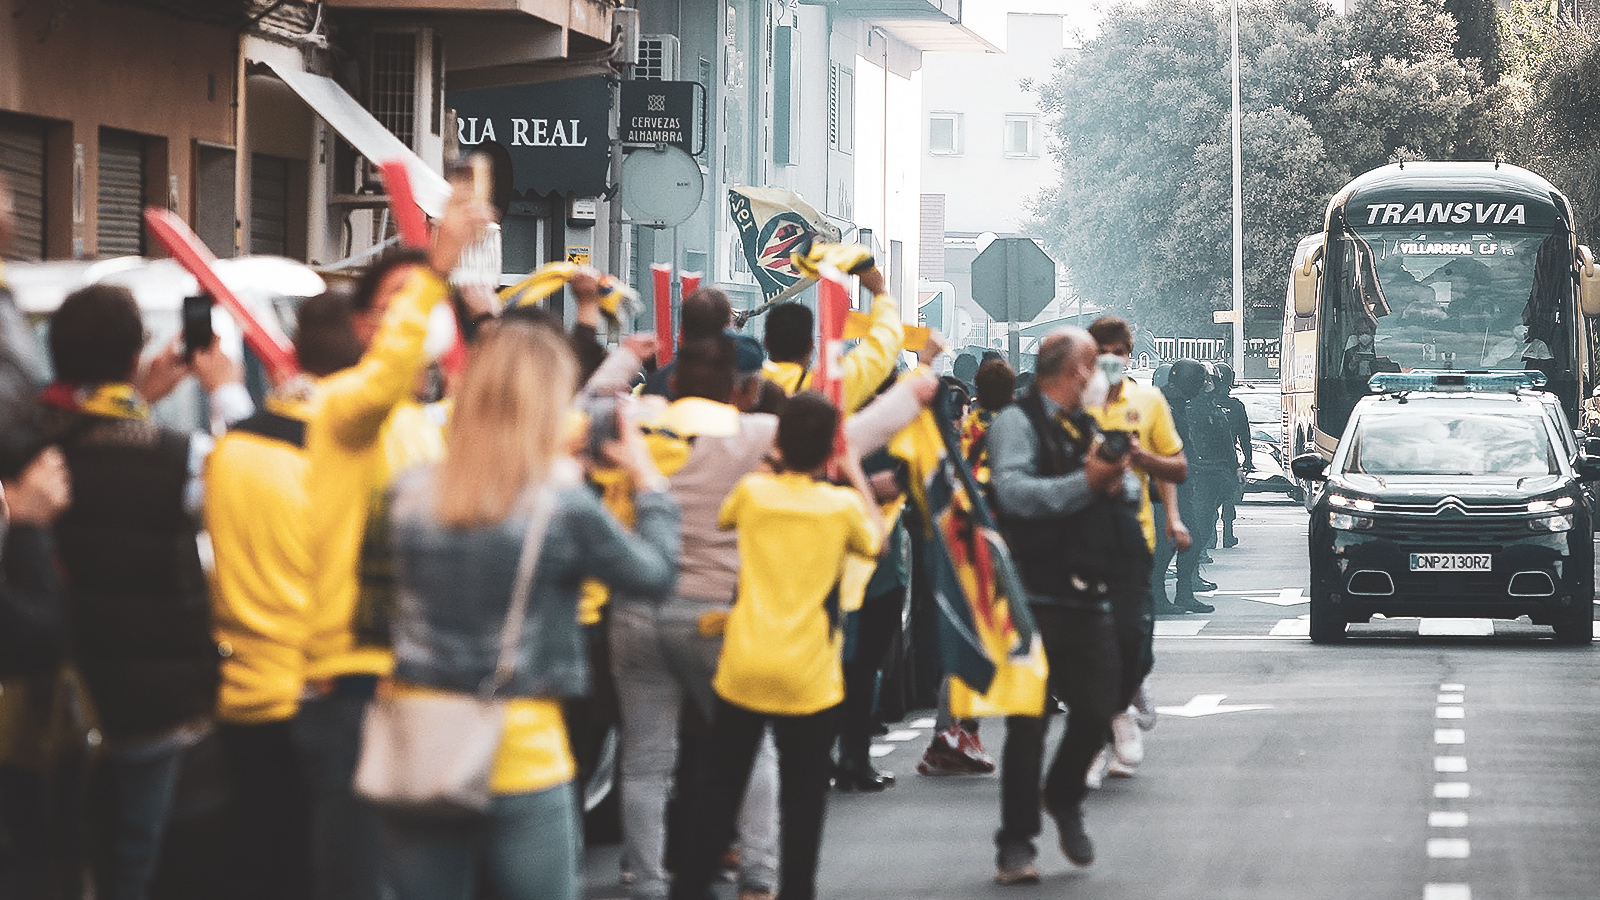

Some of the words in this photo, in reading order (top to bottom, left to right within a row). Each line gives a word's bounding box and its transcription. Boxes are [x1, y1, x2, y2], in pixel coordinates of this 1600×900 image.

[631, 116, 681, 129] CERVEZAS
[511, 118, 588, 147] REAL
[627, 130, 683, 143] ALHAMBRA
[1366, 202, 1526, 225] TRANSVIA
[1400, 242, 1474, 255] VILLARREAL
[1416, 555, 1490, 570] CNP2130RZ
